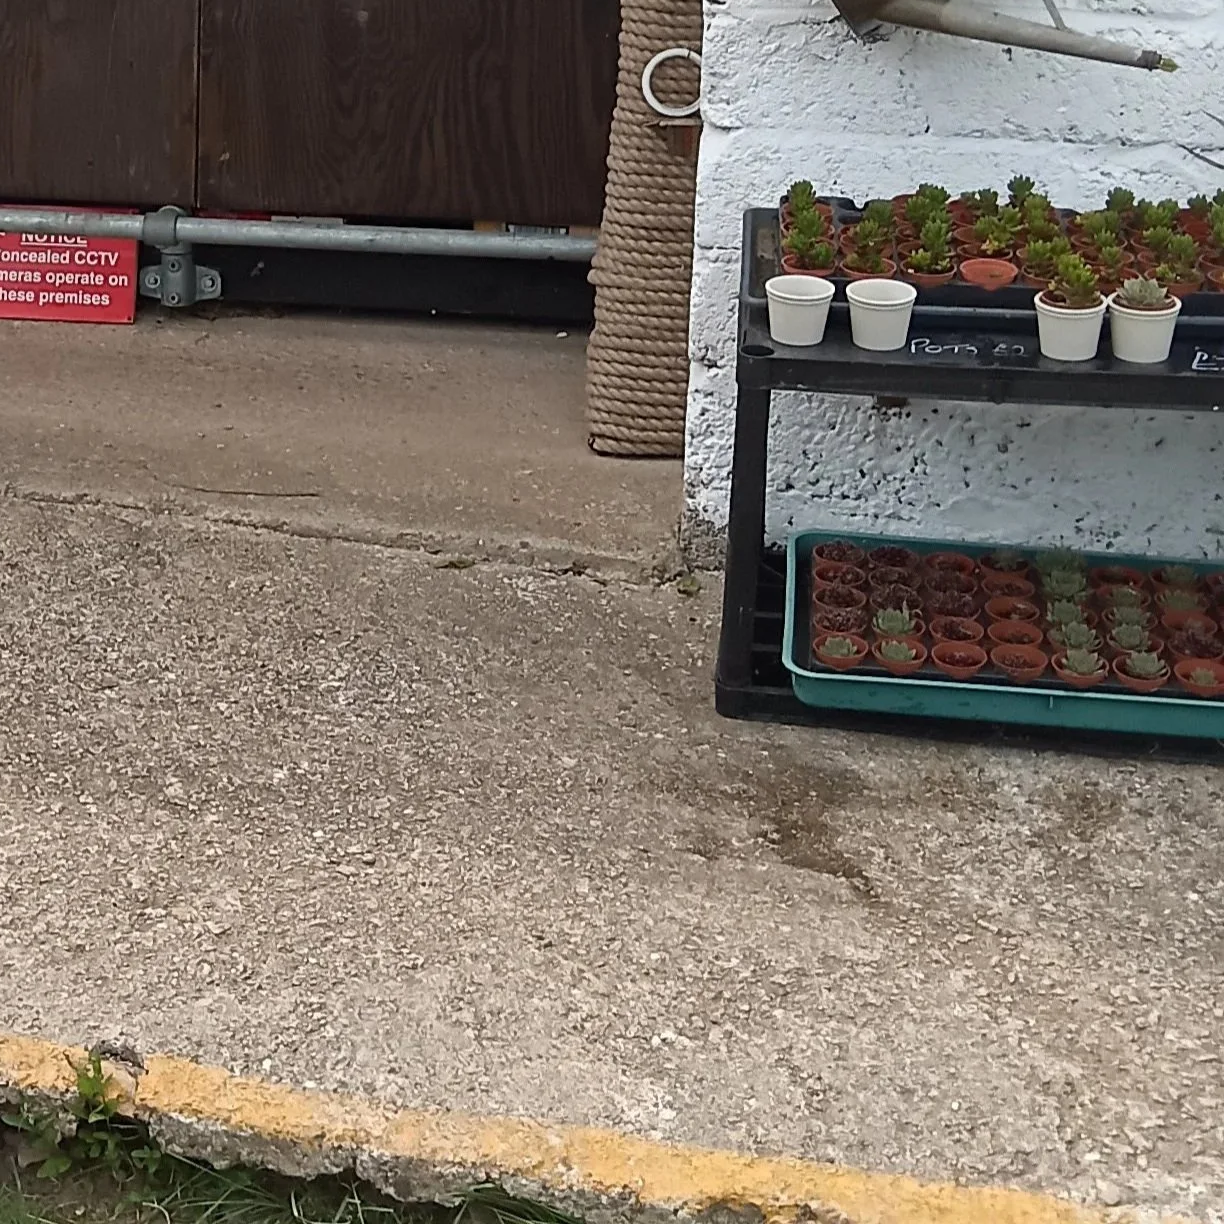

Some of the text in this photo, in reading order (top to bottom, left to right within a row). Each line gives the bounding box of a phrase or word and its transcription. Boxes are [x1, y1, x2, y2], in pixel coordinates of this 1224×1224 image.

[74, 251, 119, 266] CCTV
[45, 272, 105, 287] operate
[108, 276, 129, 286] on
[39, 290, 110, 306] premises
